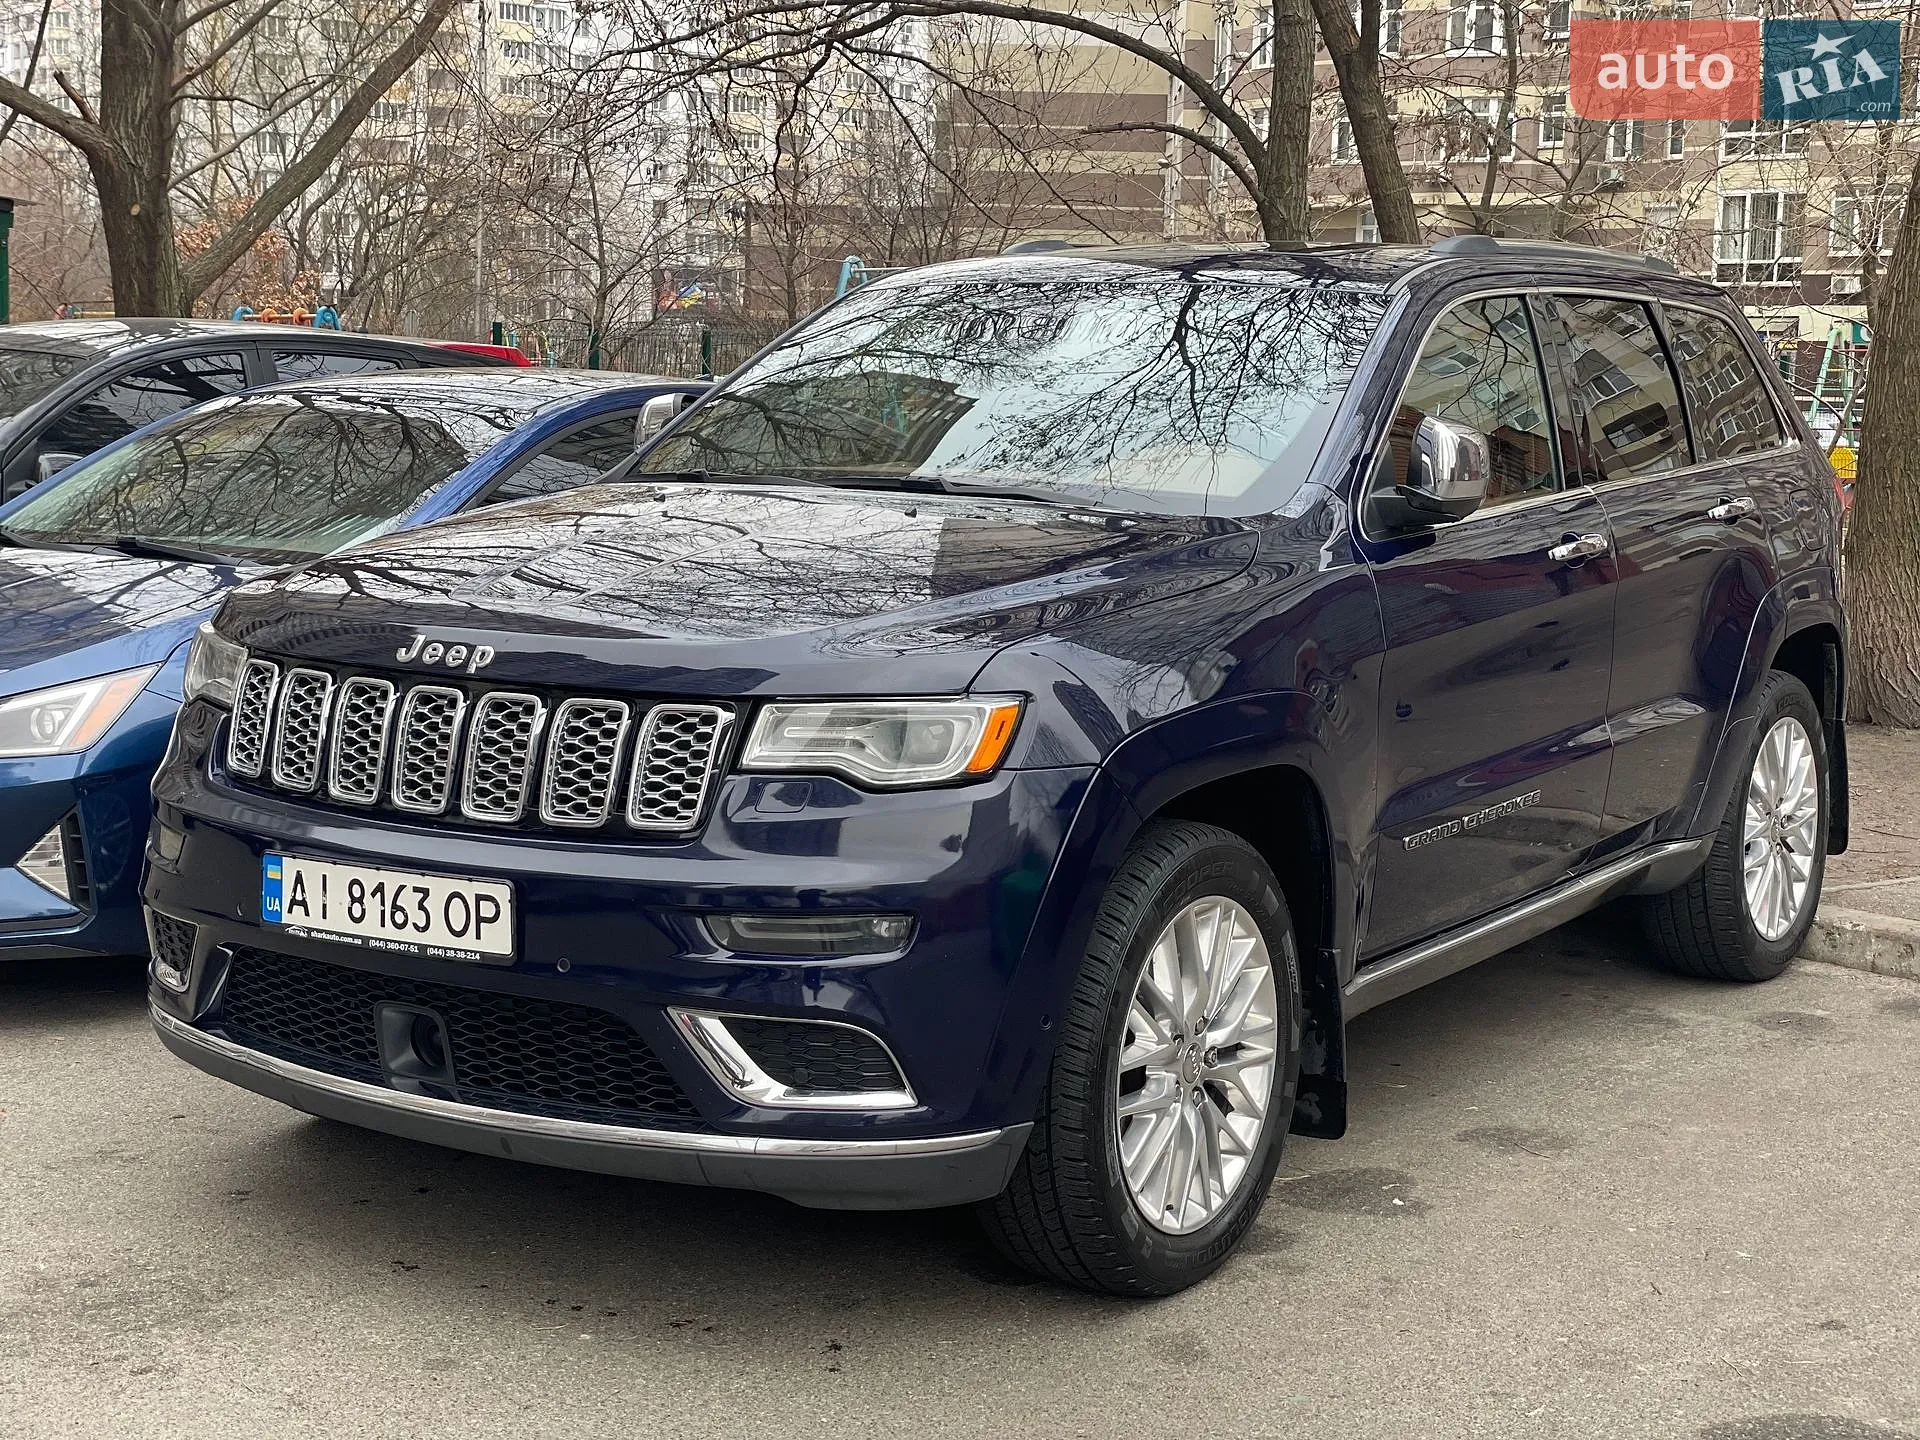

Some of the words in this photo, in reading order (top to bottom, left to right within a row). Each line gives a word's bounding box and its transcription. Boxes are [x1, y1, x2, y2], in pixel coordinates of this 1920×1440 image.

[396, 634, 495, 674] Jeep
[1403, 819, 1462, 851] GRAND
[1462, 789, 1542, 830] CHEROKEE
[266, 895, 282, 912] UA
[287, 869, 328, 920] AI
[347, 877, 431, 934] 8163
[443, 890, 501, 941] OP
[310, 930, 362, 945] sharkauto.com.ua
[368, 939, 386, 950] (044)
[426, 946, 445, 958] (044)
